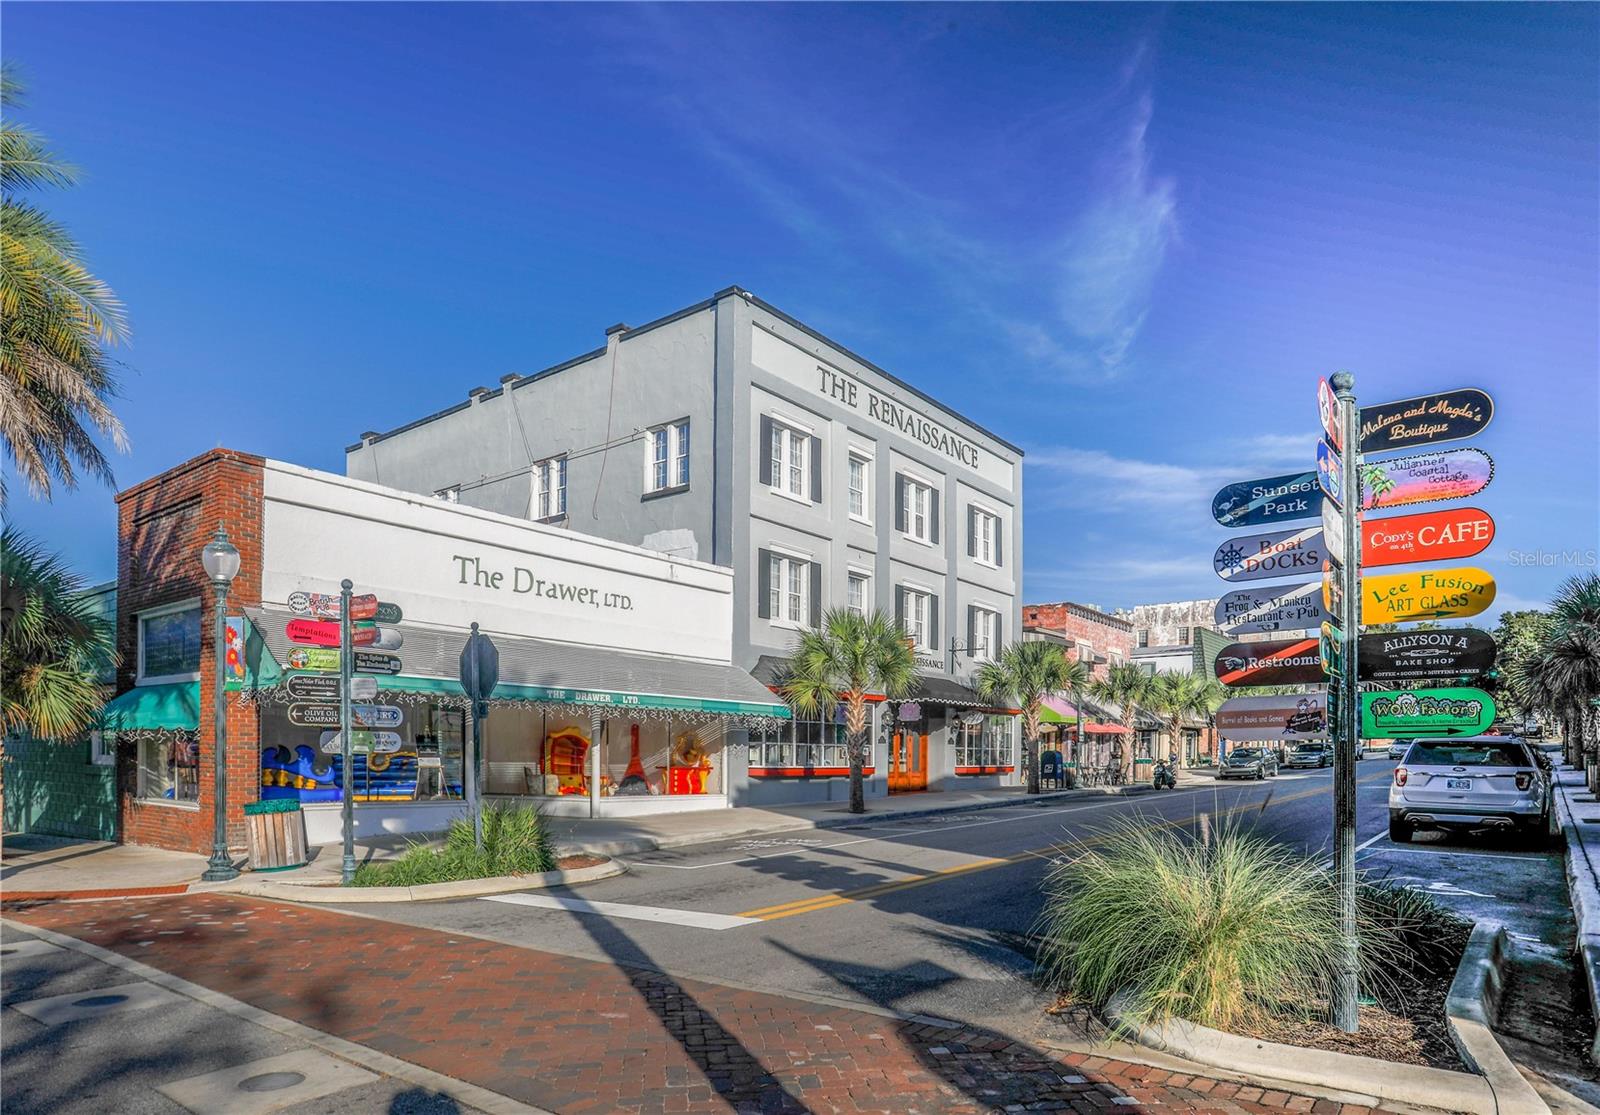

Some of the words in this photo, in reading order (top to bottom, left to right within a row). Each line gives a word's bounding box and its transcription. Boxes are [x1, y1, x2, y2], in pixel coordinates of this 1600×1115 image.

[817, 365, 857, 408] THE
[868, 393, 978, 469] RENAISSANCE
[1403, 401, 1427, 417] and
[1428, 400, 1482, 422] Magda's
[1389, 423, 1449, 440] Boutique
[1409, 464, 1449, 478] Coastal
[1428, 471, 1469, 484] Cottage
[1252, 480, 1319, 499] Sunset
[1263, 499, 1308, 516] Park
[1417, 519, 1489, 546] CAFE
[1259, 537, 1303, 555] Boat
[1400, 542, 1414, 550] 4th
[1246, 550, 1319, 573] DOCKS
[452, 555, 504, 589] The
[512, 567, 600, 608] Drawer,
[604, 593, 634, 610] LTD.
[1373, 583, 1409, 603] Lee
[1420, 574, 1484, 595] Fusion
[1224, 602, 1249, 614] Frog
[1253, 600, 1264, 610] &
[1386, 598, 1414, 612] ART
[1420, 593, 1469, 609] GLASS
[1224, 609, 1285, 625] Restaurant
[1285, 611, 1295, 620] &
[1296, 605, 1320, 620] Pub
[291, 623, 336, 639] Temptations
[1383, 634, 1453, 652] ALLYSON
[1455, 637, 1468, 648] A
[1248, 655, 1320, 669] Restrooms
[1395, 658, 1422, 666] BAKE
[1426, 657, 1455, 665] SHOP
[547, 690, 565, 699] THE
[1376, 702, 1417, 716] WOW
[1421, 703, 1478, 718] Factory
